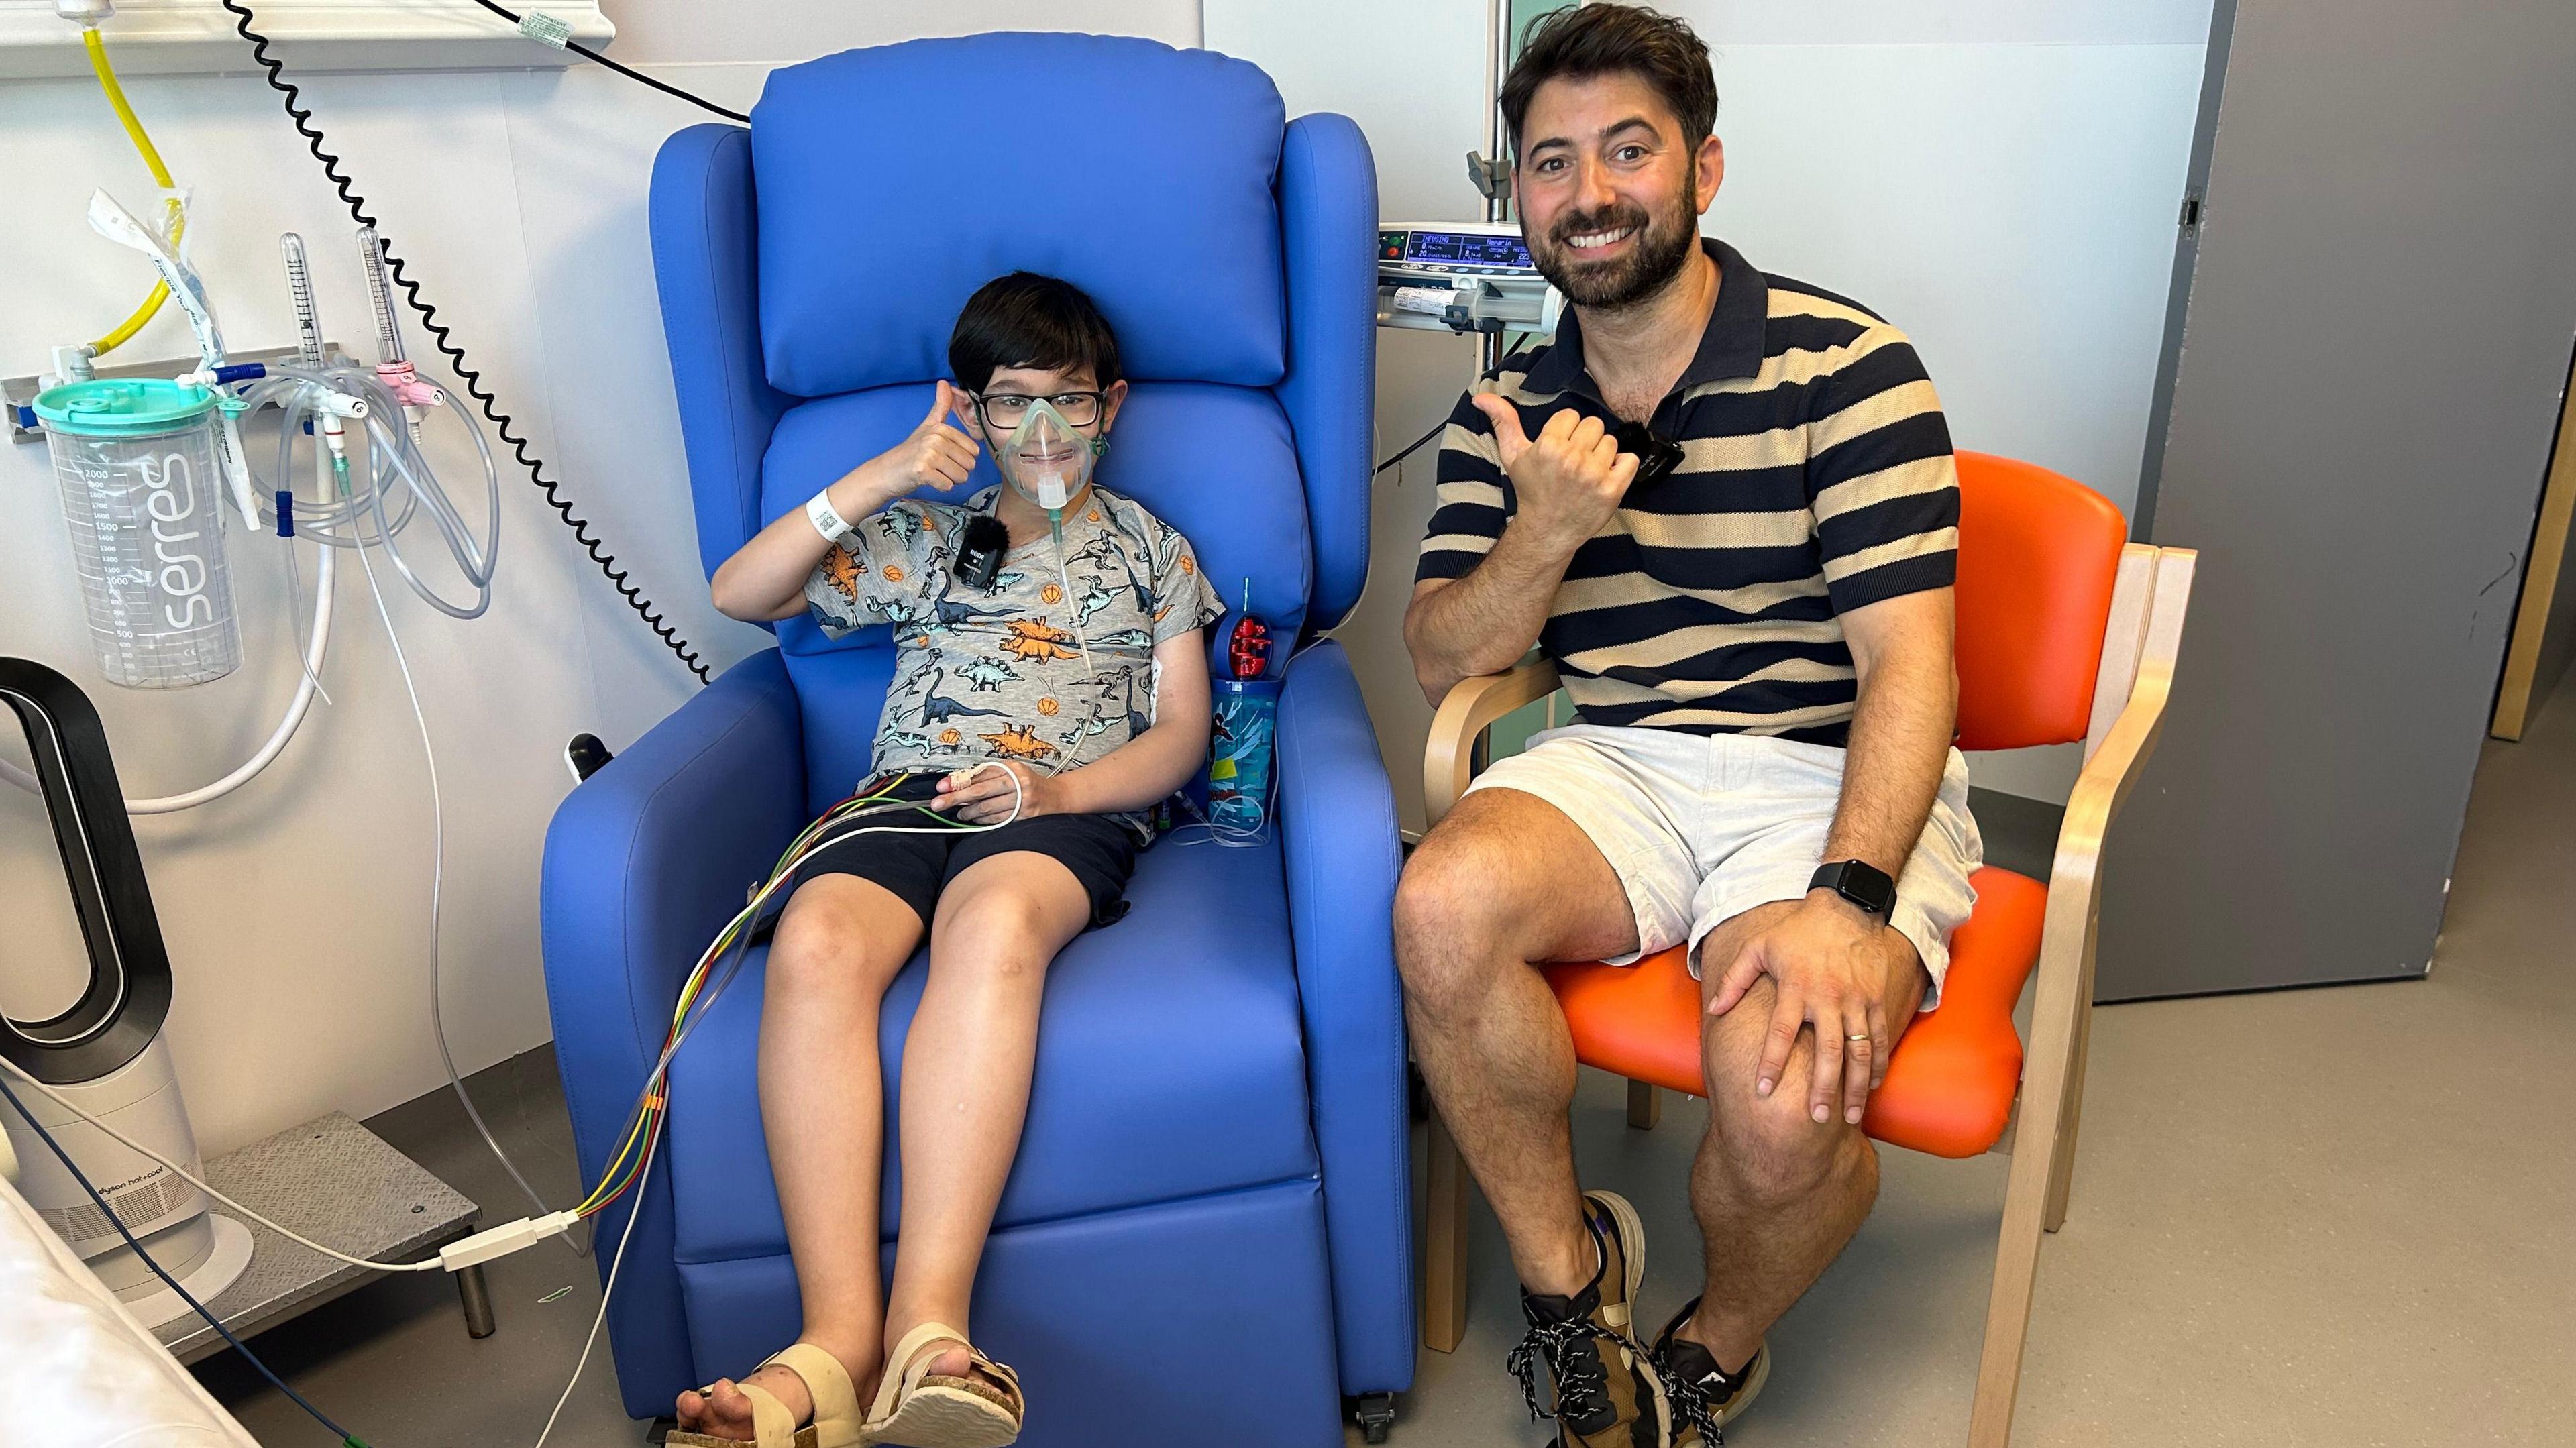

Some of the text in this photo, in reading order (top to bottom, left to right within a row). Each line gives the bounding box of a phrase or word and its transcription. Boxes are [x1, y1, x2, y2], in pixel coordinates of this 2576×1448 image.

[537, 13, 566, 27] IMPORTANT
[1422, 235, 1449, 243] INFUSING
[85, 470, 108, 478] 2000
[95, 522, 119, 531] 1500
[141, 453, 213, 628] serres
[106, 577, 128, 585] 1000
[117, 630, 133, 638] 500
[98, 1166, 163, 1194] dyson hot+cool
